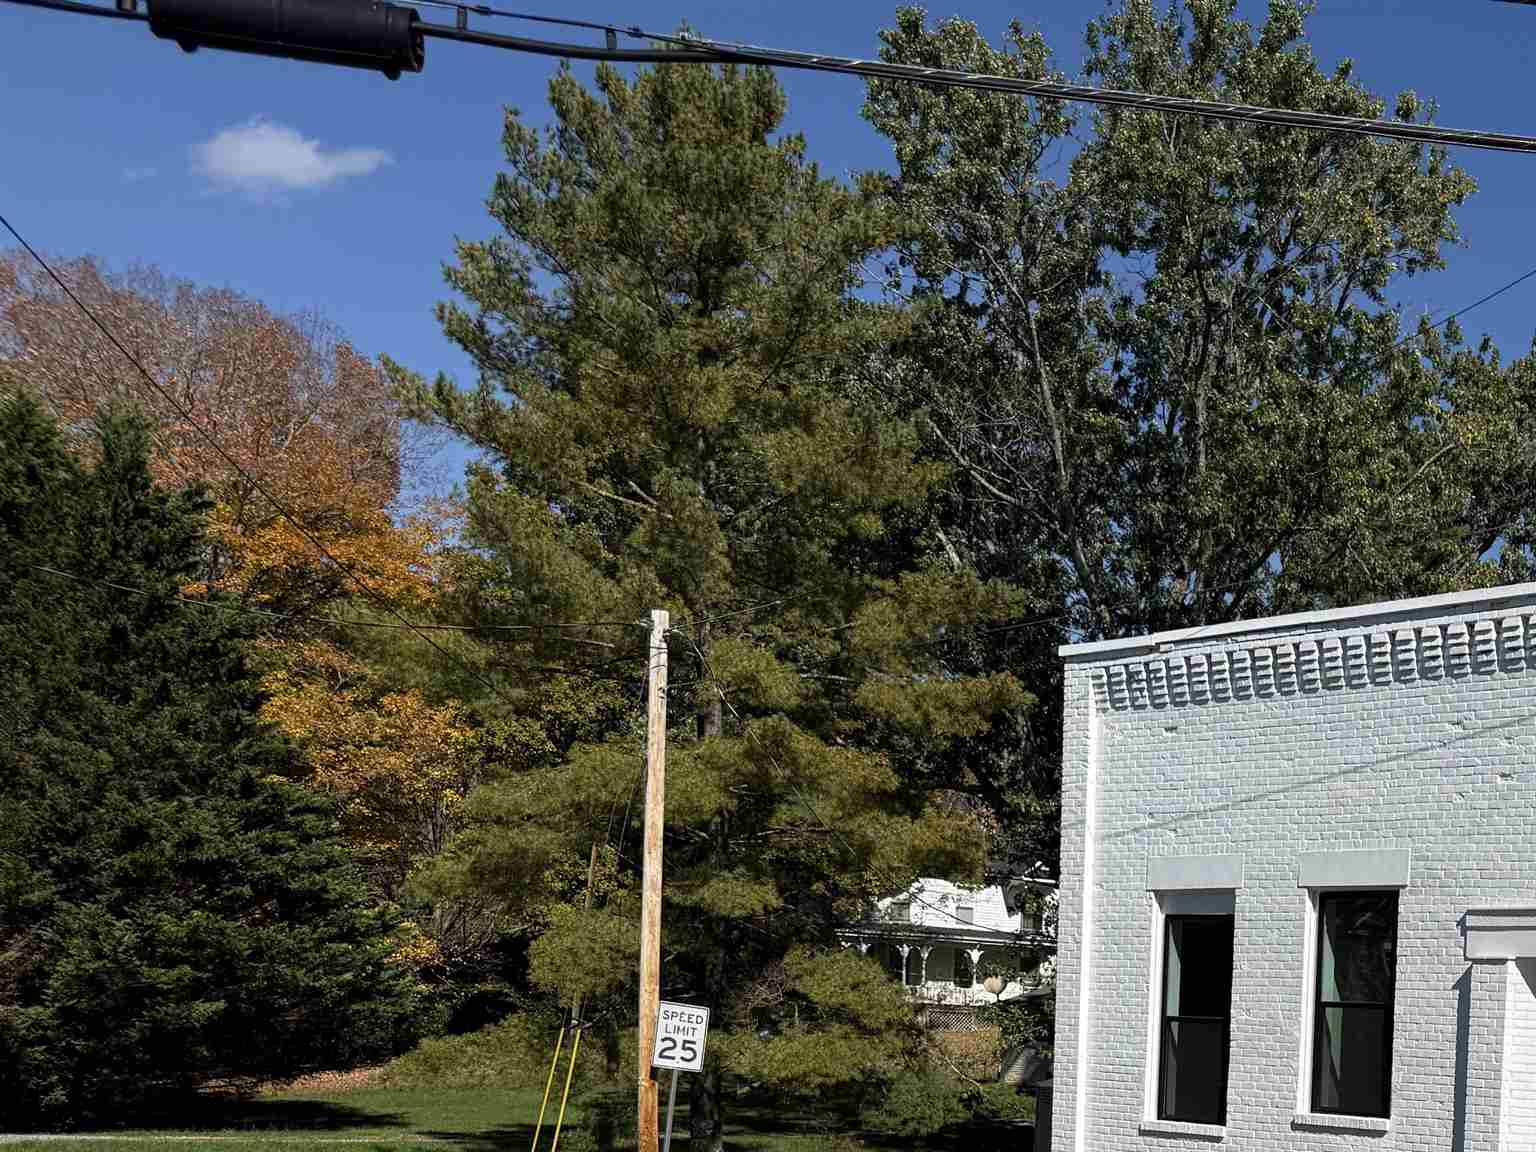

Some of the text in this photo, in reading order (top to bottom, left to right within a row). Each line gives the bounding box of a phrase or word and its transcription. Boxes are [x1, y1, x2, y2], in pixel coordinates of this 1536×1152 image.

[663, 1009, 704, 1025] SPEED
[665, 1023, 697, 1037] LIMIT
[658, 1036, 697, 1062] 25
